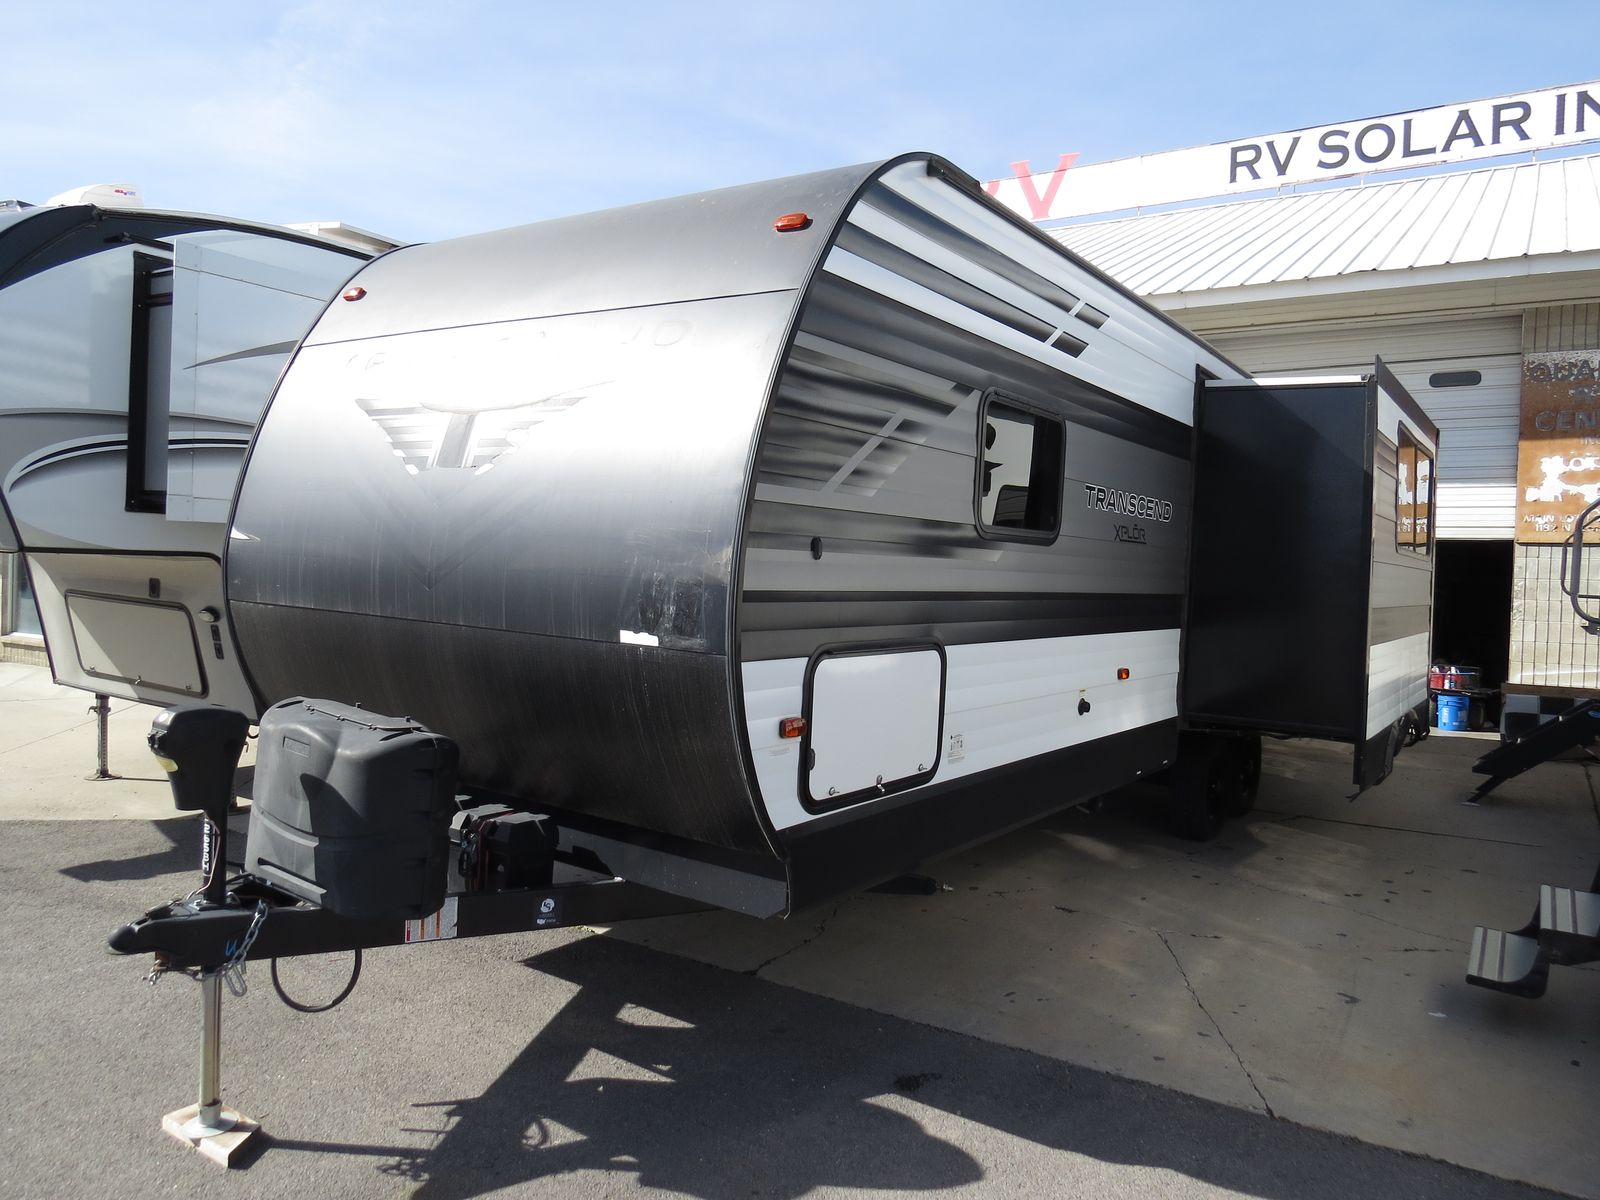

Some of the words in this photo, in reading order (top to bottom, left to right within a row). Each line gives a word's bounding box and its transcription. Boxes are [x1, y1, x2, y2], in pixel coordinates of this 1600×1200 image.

[1229, 136, 1301, 184] RV
[1316, 100, 1531, 169] SOLAR
[1536, 410, 1600, 431] CEN
[1085, 484, 1173, 523] TRANSCEND
